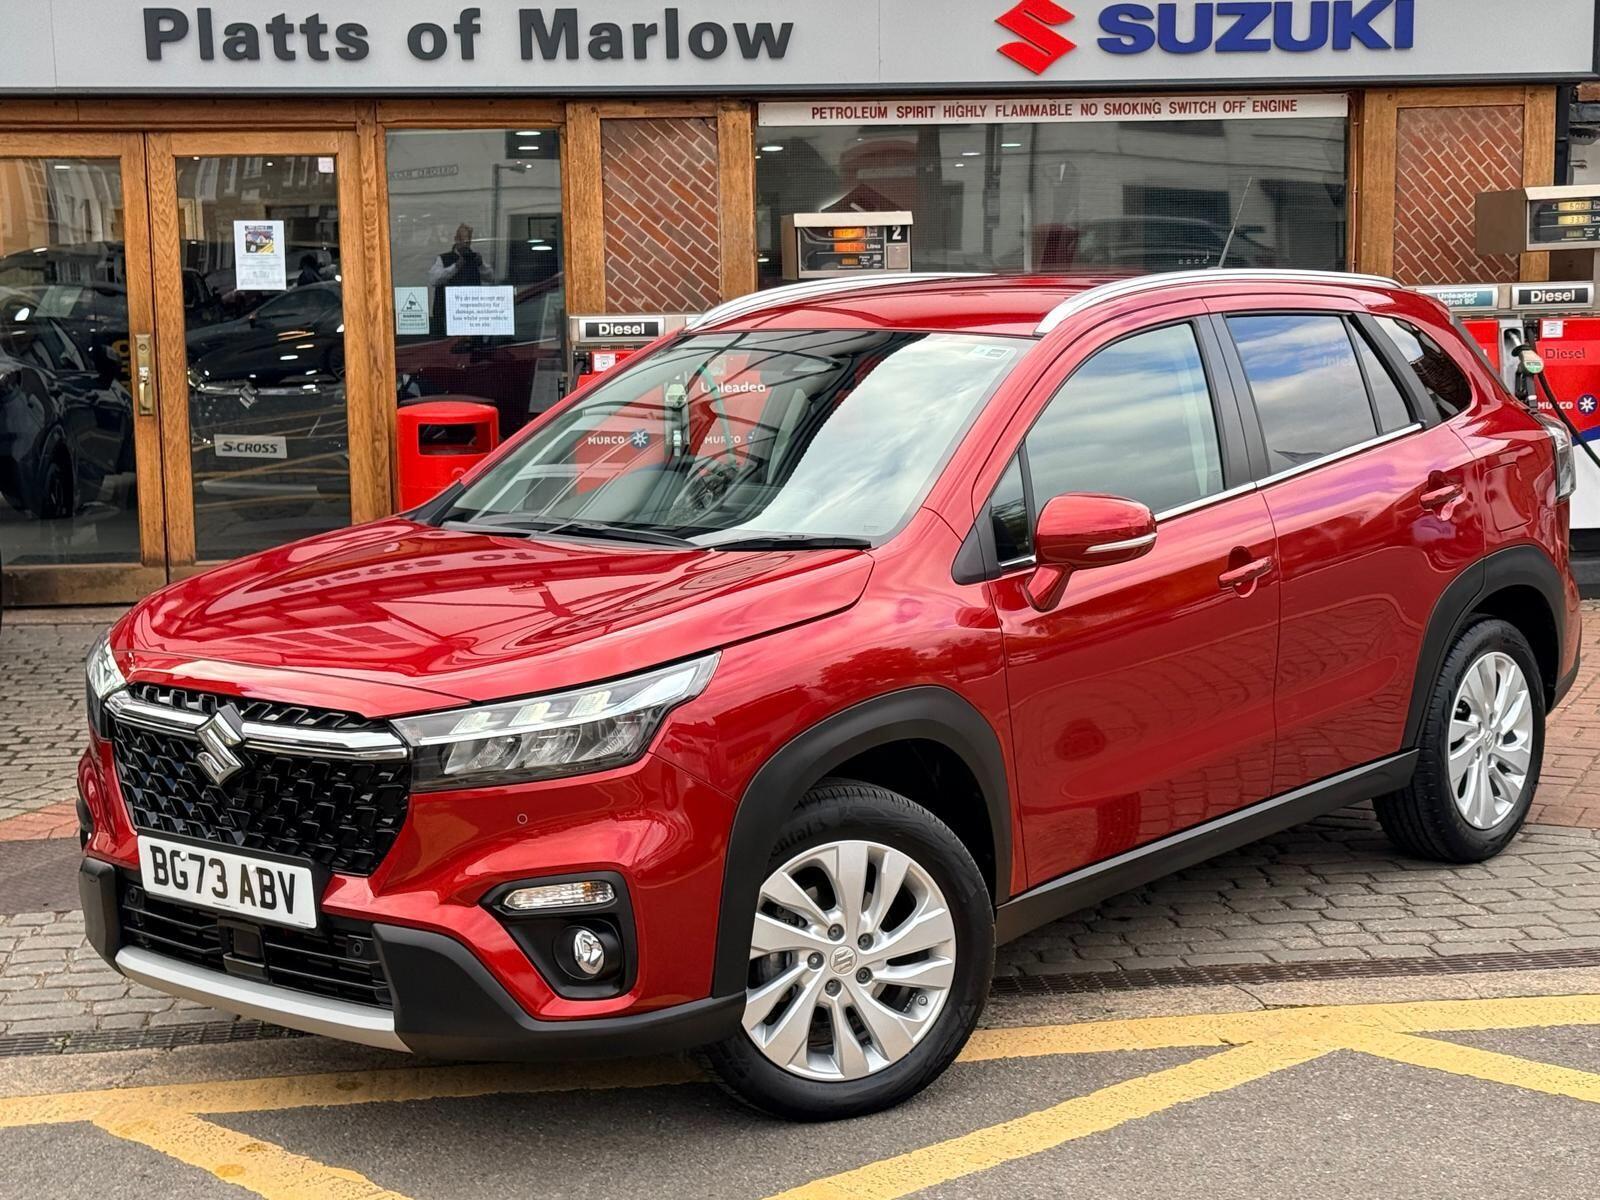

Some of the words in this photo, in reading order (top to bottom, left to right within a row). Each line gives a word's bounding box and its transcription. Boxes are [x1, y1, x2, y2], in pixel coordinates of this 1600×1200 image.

[143, 7, 370, 61] Platts
[406, 7, 481, 61] of
[518, 8, 794, 60] Marlow
[1097, 0, 1414, 54] SUZUKI
[811, 106, 888, 120] PETROLEUM
[896, 105, 936, 119] SPIRIT
[943, 104, 987, 118] HIGHLY
[995, 103, 1073, 118] FLAMMABLE
[1080, 103, 1098, 116] NO
[1104, 102, 1162, 115] SMOKING
[1169, 101, 1216, 114] SWITCH
[1223, 100, 1247, 113] OFF
[1252, 99, 1298, 113] ENGINE
[892, 225, 902, 240] 2
[1530, 290, 1576, 303] Diesel
[598, 322, 646, 336] Diesel
[1545, 348, 1586, 359] Diesel
[1537, 401, 1574, 410] MUCO
[588, 436, 625, 445] MURCO
[150, 845, 229, 899] BG73
[239, 863, 296, 914] ABV
